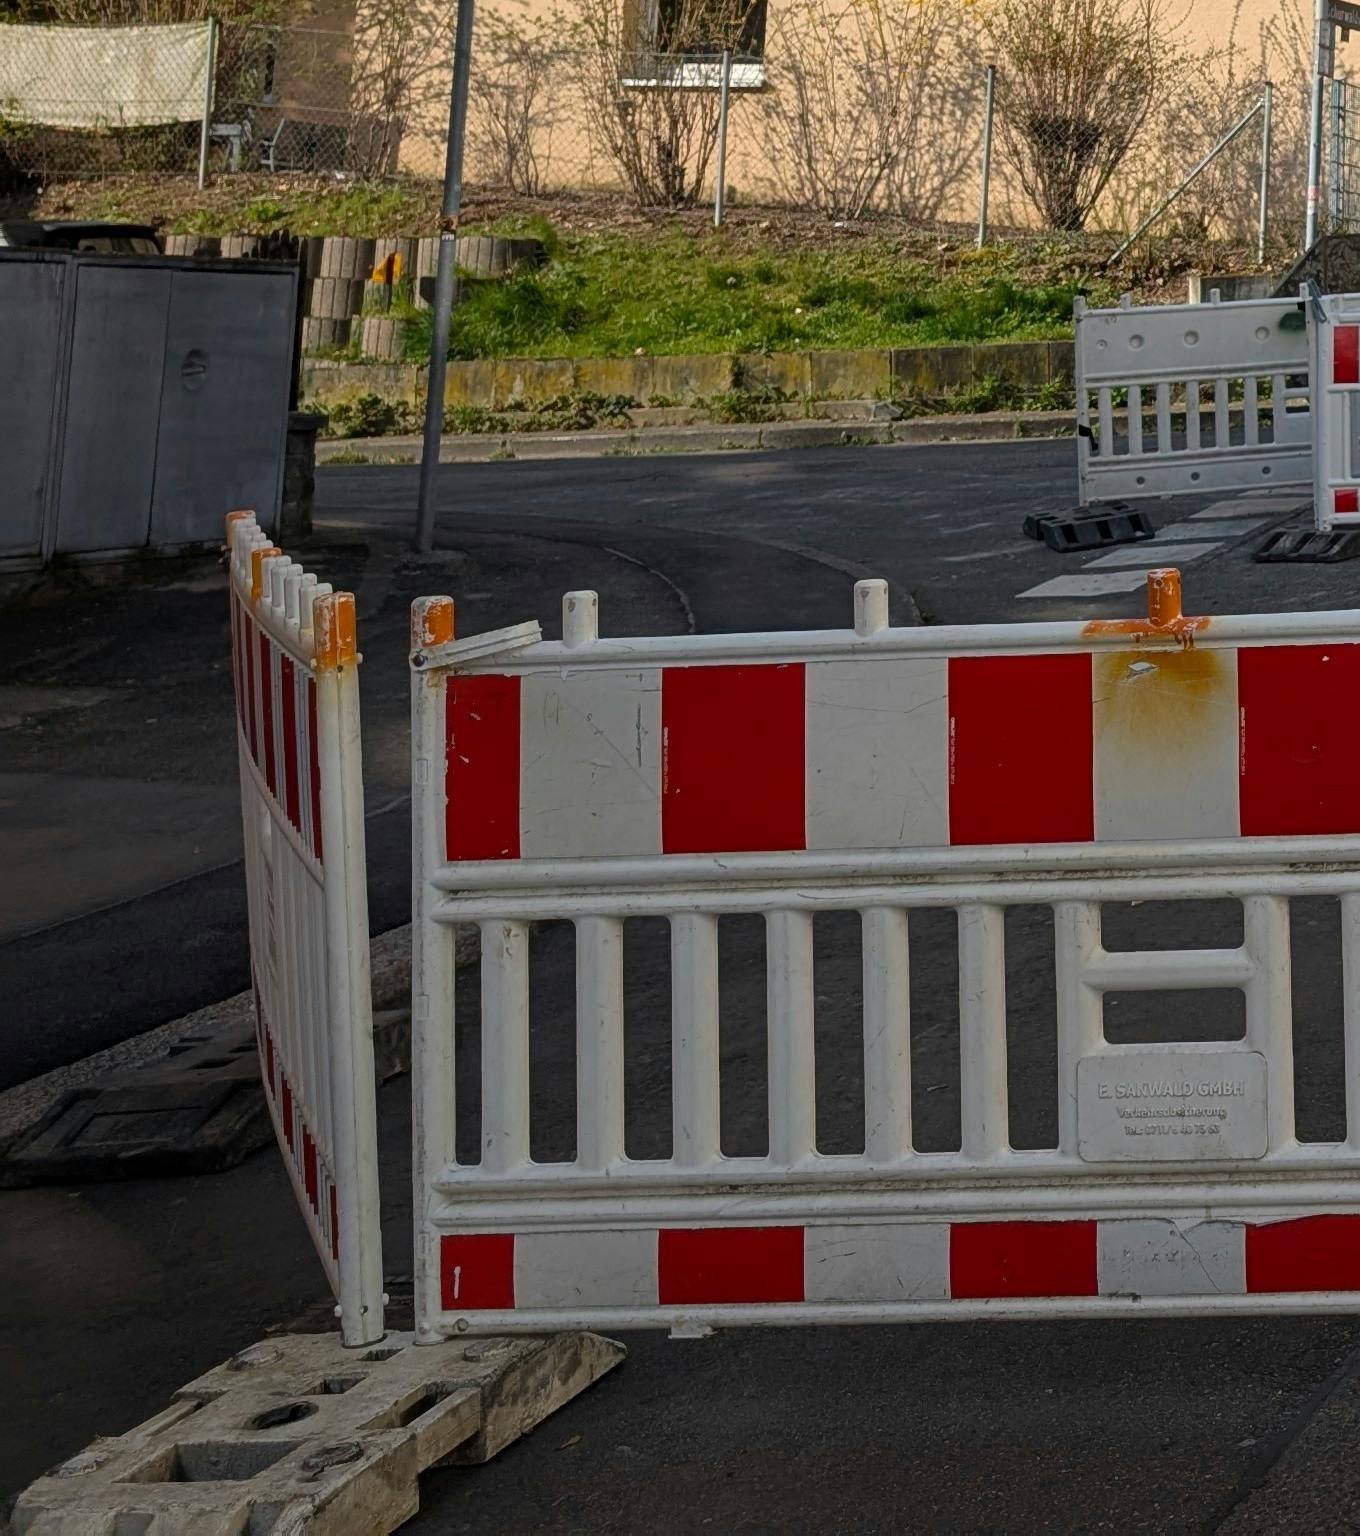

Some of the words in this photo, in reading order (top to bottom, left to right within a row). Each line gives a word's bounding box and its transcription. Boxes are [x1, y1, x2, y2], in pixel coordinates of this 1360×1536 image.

[1098, 1082, 1113, 1099] E.
[1115, 1080, 1194, 1099] SANWALD
[1197, 1080, 1245, 1097] GMBH
